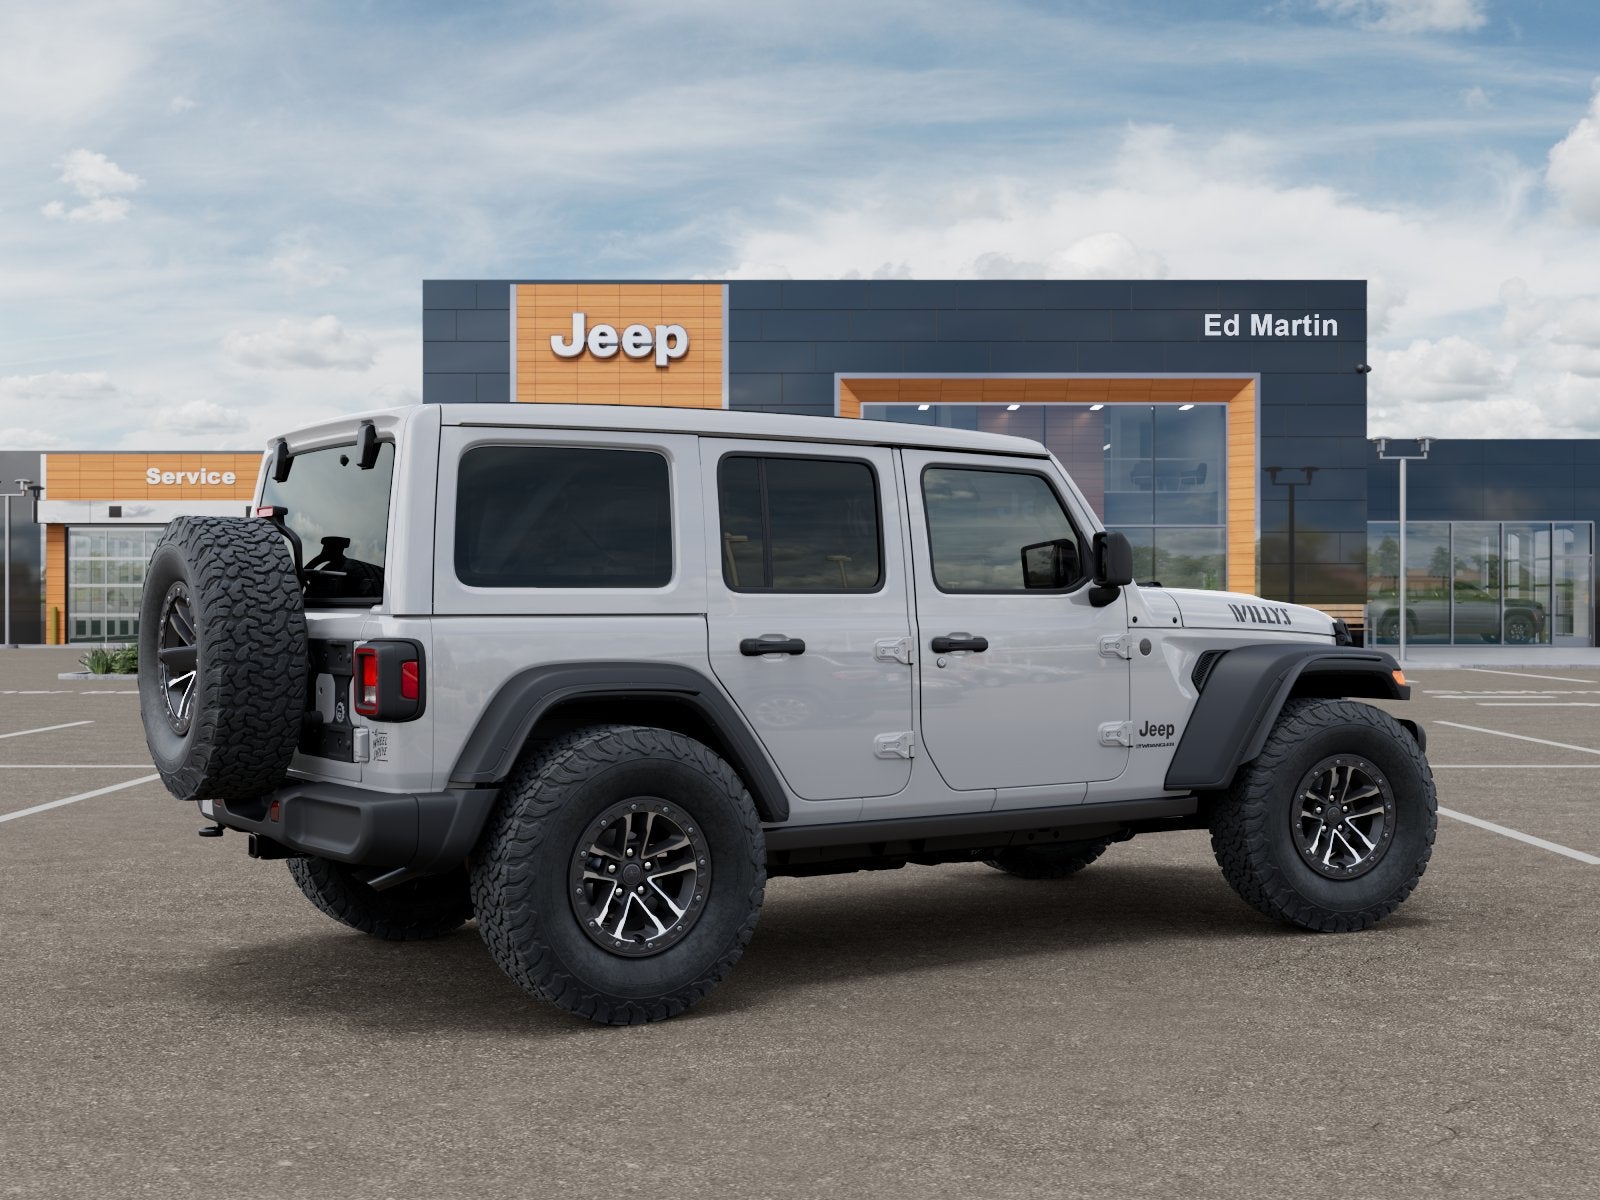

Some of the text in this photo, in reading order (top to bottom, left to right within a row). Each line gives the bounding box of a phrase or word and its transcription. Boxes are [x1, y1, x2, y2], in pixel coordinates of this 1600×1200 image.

[1204, 313, 1338, 337] Ed Martin
[550, 311, 688, 367] Jeep
[146, 467, 236, 485] Service
[1227, 603, 1292, 625] WILLYS
[1139, 720, 1175, 739] Jeep
